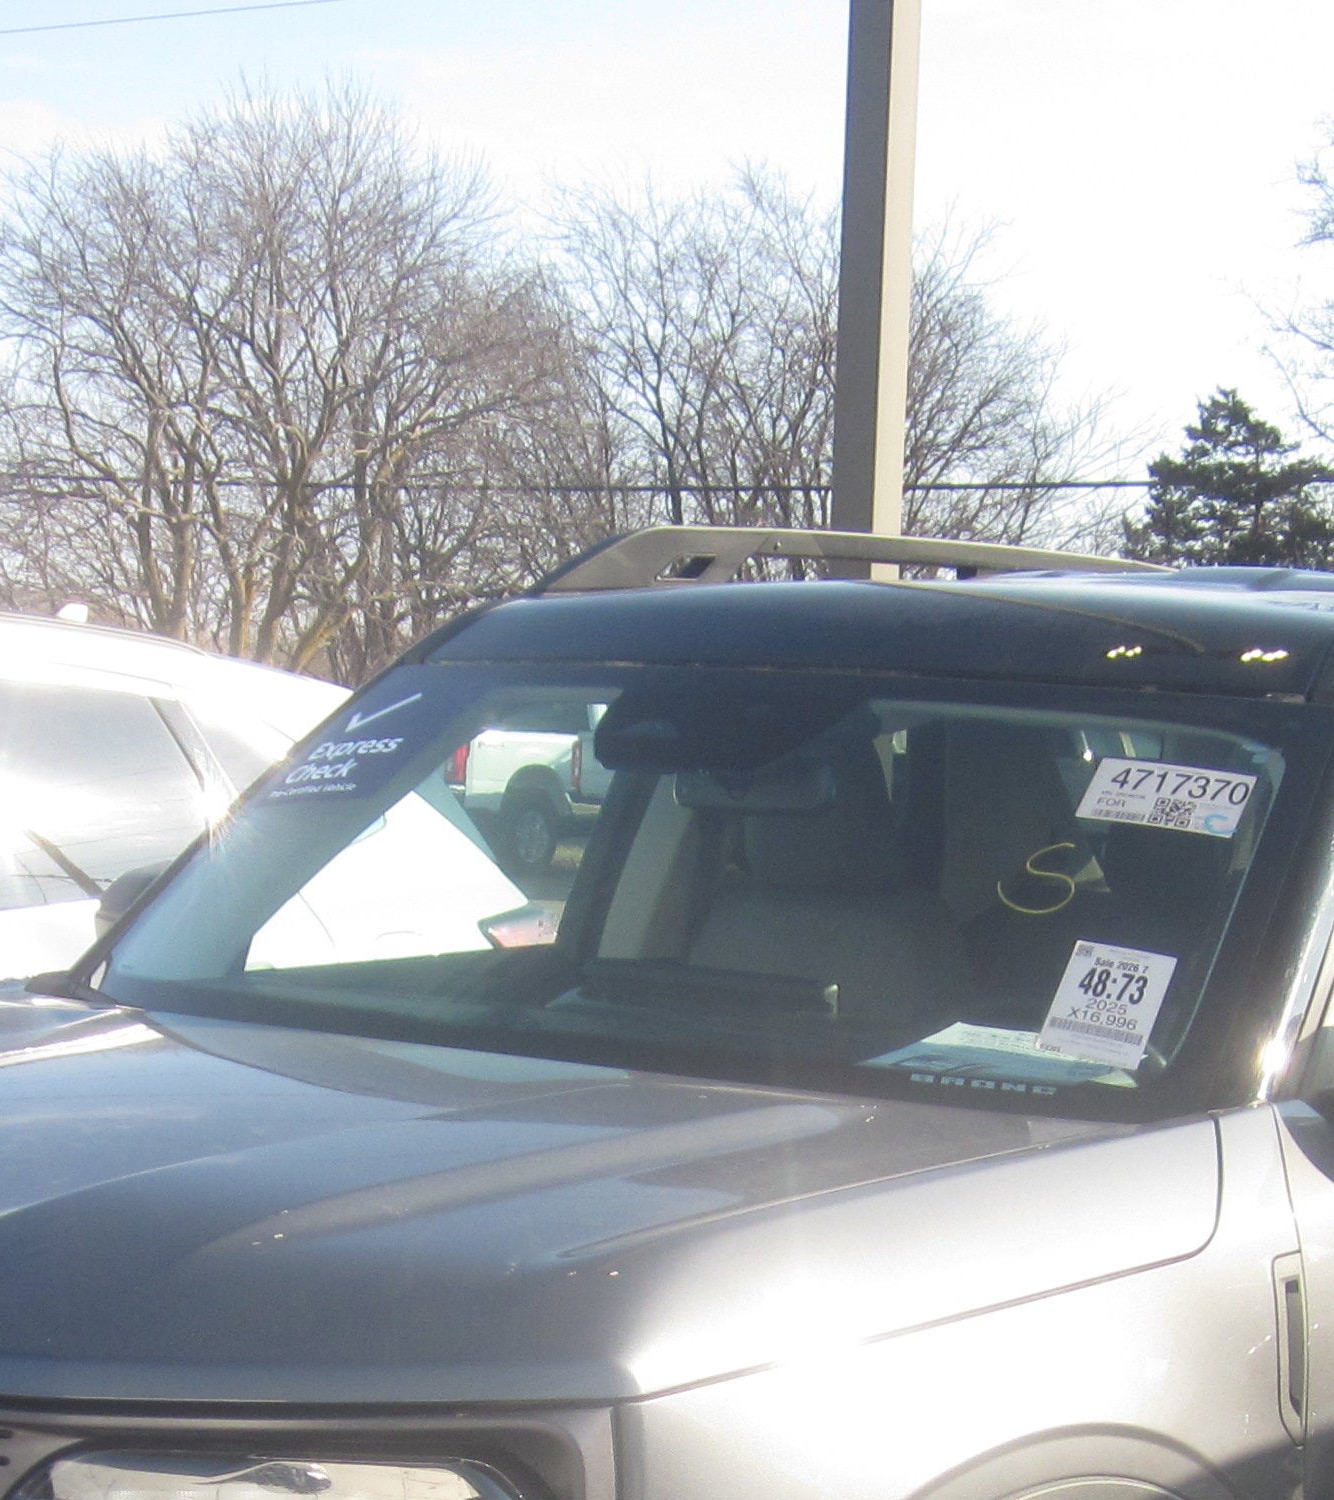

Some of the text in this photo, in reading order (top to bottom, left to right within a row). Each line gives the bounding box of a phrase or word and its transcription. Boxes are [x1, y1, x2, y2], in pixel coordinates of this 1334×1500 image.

[308, 737, 404, 761] Express
[286, 758, 358, 784] Check
[1111, 768, 1250, 806] 4717370
[1094, 957, 1115, 970] Sale
[1116, 960, 1140, 974] 2026
[1078, 967, 1149, 1005] 48:73
[1068, 1006, 1138, 1032] X16,996
[1085, 997, 1127, 1016] 2025
